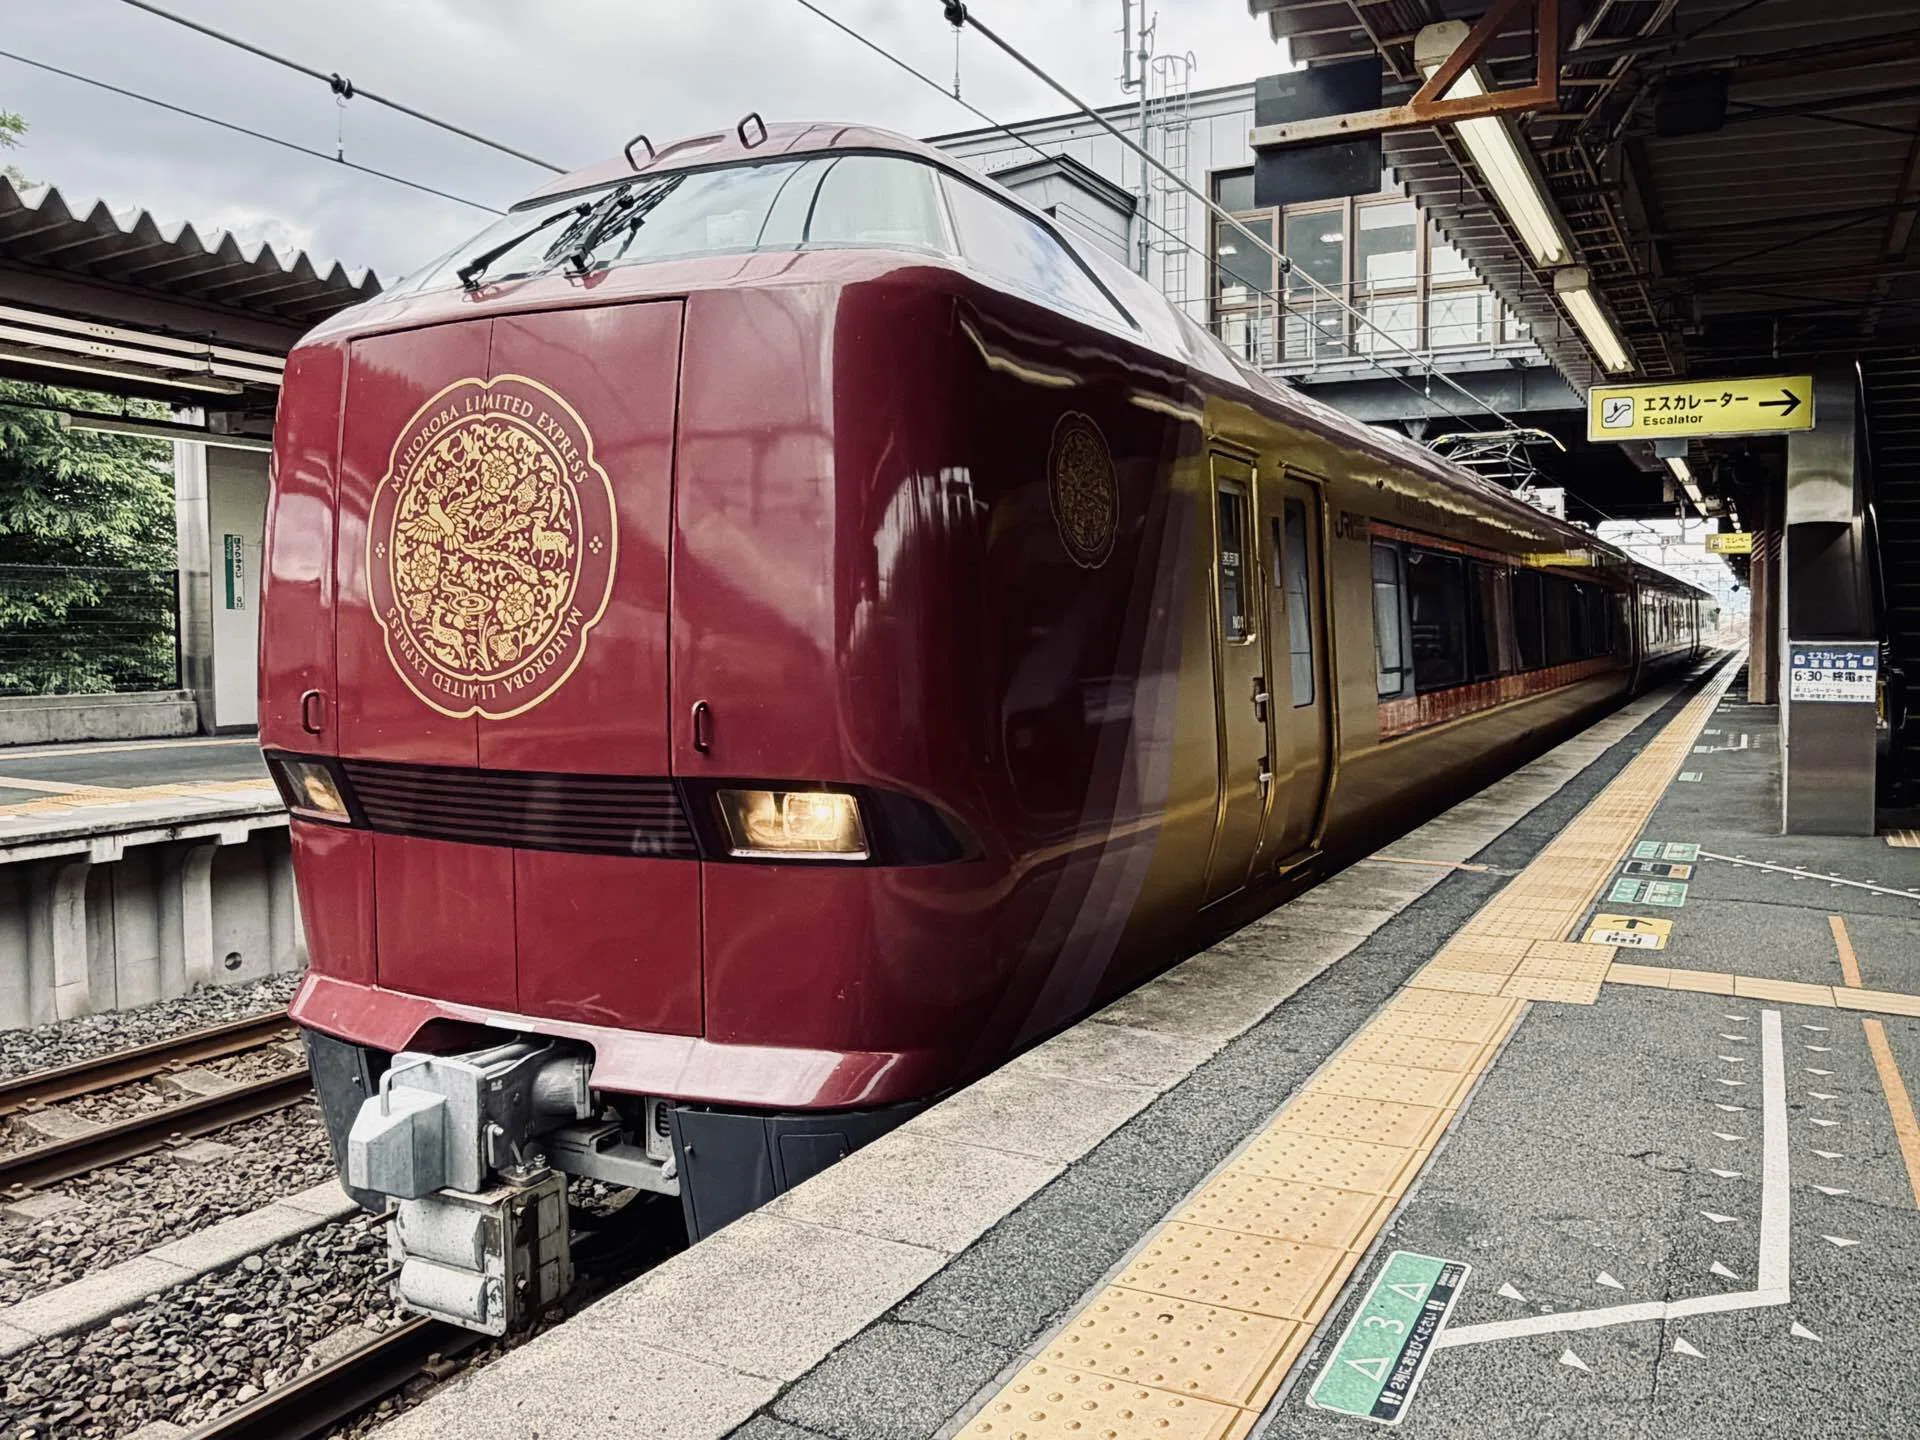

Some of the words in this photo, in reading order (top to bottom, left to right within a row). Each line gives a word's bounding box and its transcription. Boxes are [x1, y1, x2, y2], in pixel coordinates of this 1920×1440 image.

[1643, 391, 1749, 412] エスカレーター
[1643, 414, 1704, 427] Escalator
[391, 403, 460, 494] MAHOROBA
[465, 393, 534, 417] LIMITED
[536, 411, 590, 484] EXPRESS
[386, 606, 429, 676] EXPRESS
[502, 605, 584, 693] MAHOROBA
[1807, 652, 1861, 660] エスカレーター
[432, 672, 496, 700] LIMITED
[1363, 1315, 1405, 1336] 3
